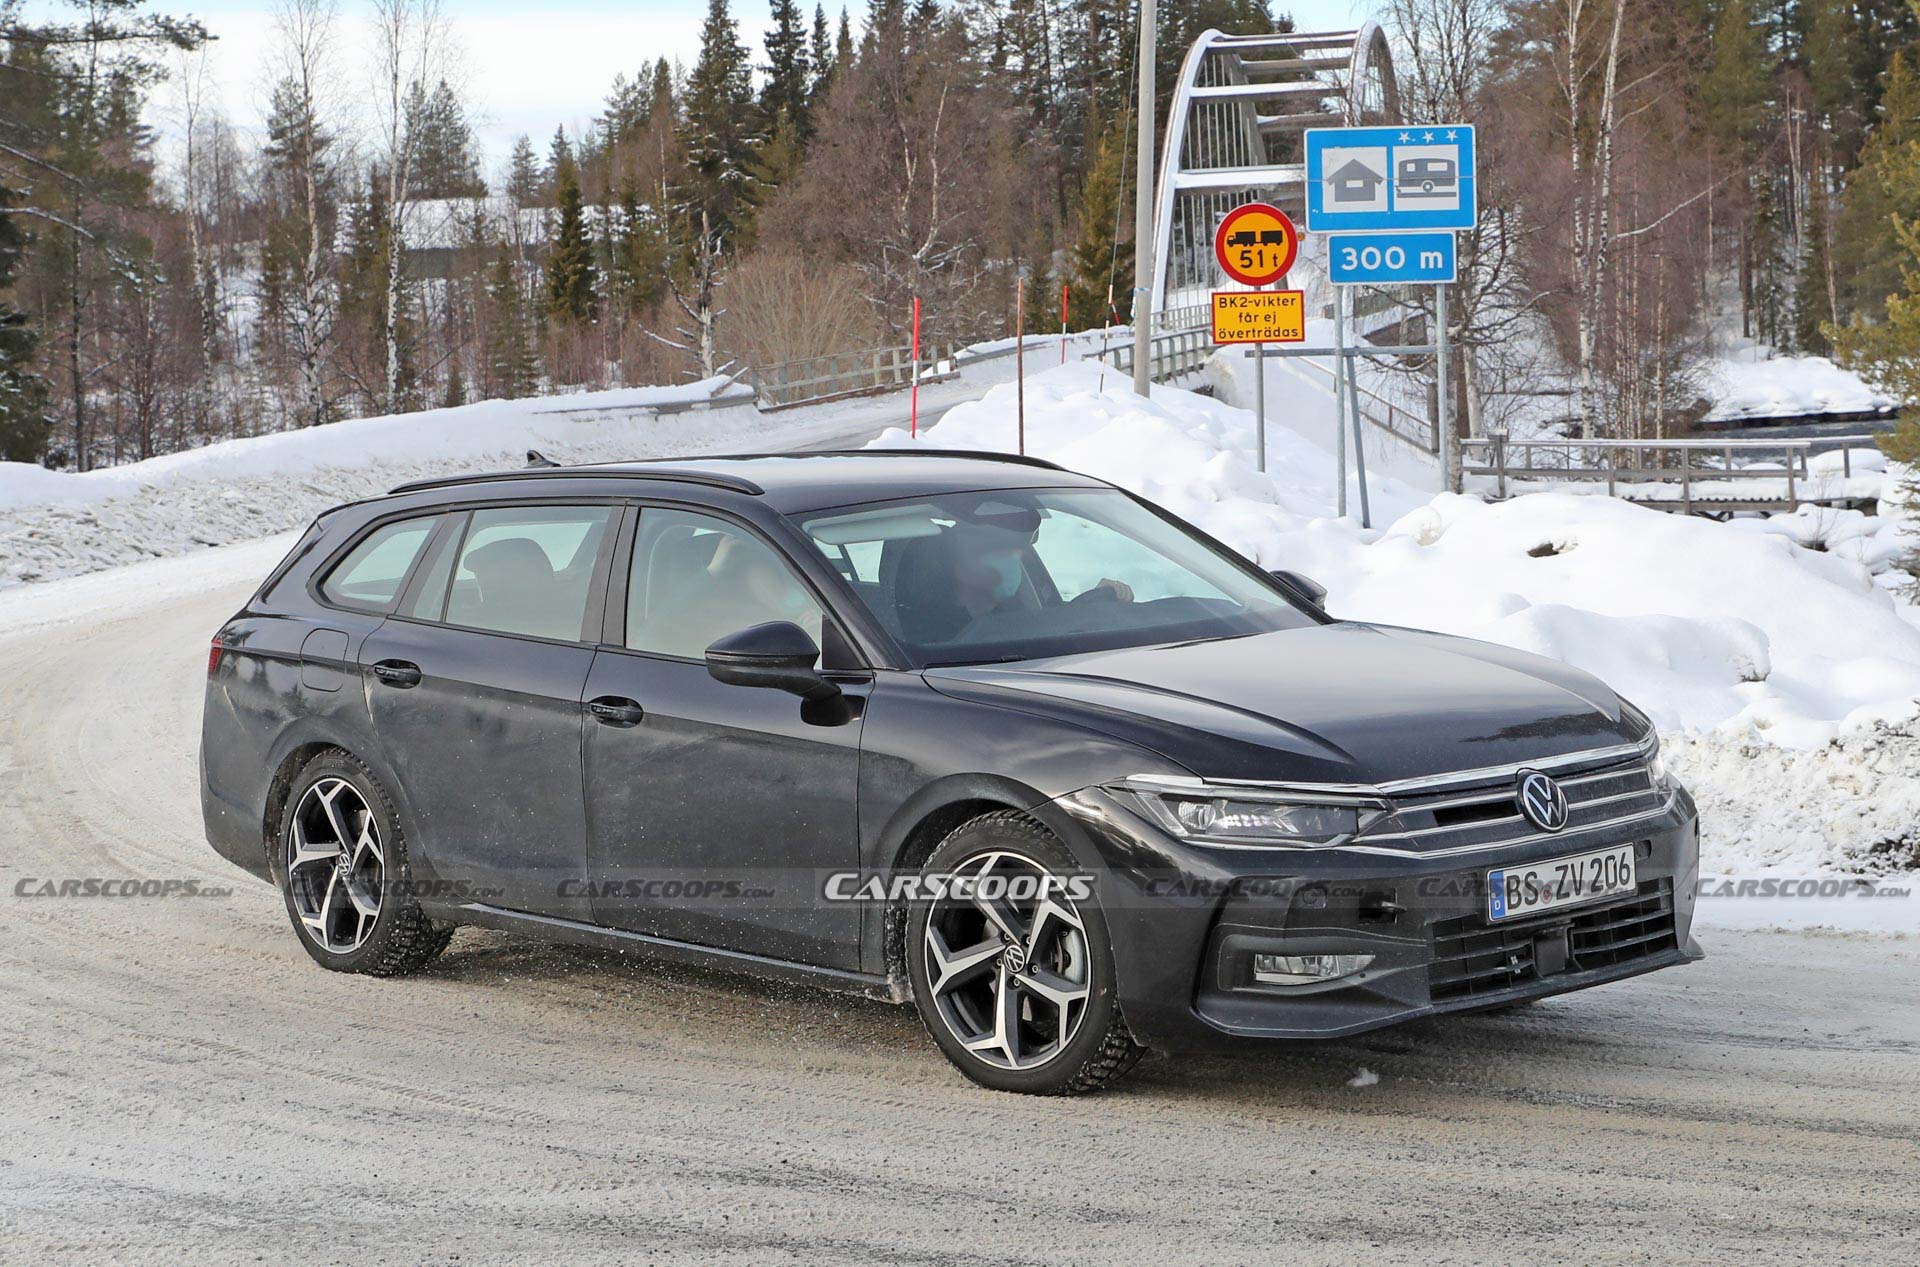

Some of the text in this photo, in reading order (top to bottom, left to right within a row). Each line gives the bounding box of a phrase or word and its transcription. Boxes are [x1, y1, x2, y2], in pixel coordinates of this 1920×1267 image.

[1240, 249, 1279, 268] 51 t
[1341, 246, 1443, 270] 300 m
[1219, 296, 1296, 309] BK2-vikter
[1239, 312, 1277, 324] får ej
[1218, 327, 1298, 339] överträdas
[1506, 871, 1539, 910] BS
[1555, 861, 1584, 900] ZV
[1590, 852, 1631, 893] 206
